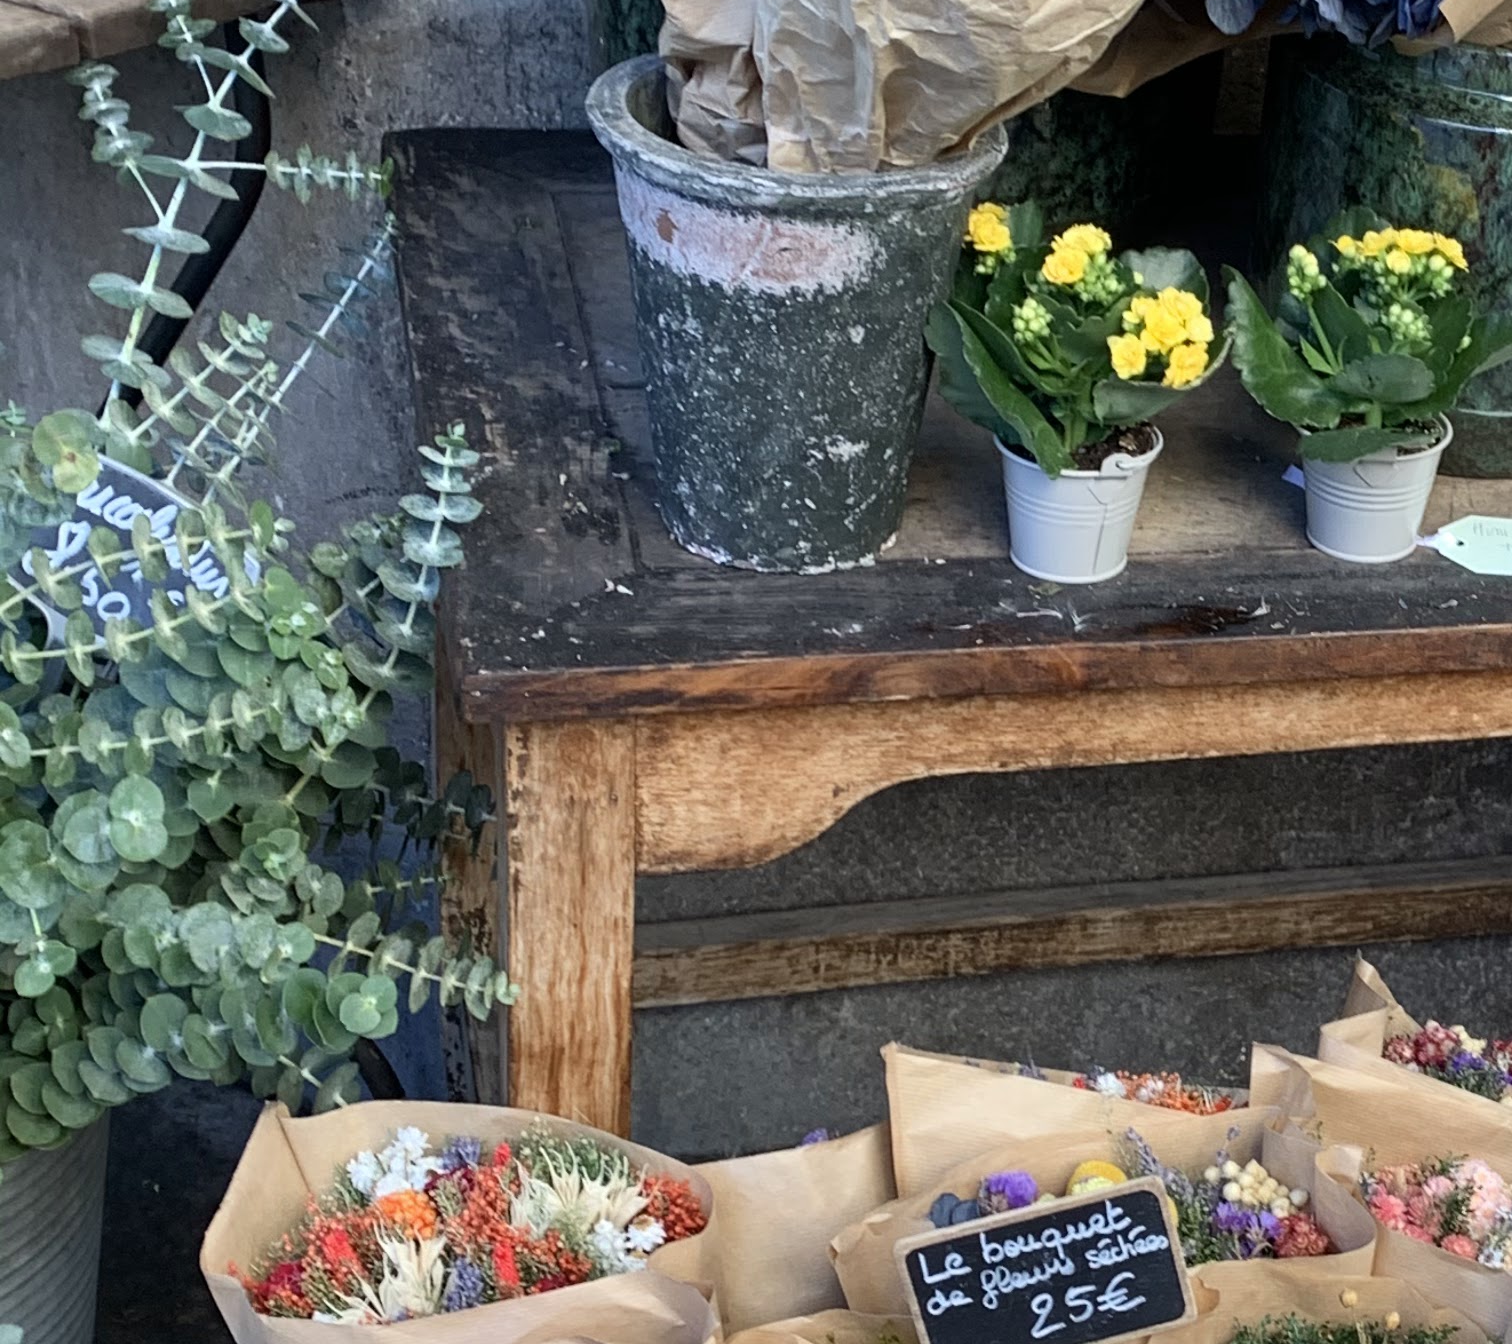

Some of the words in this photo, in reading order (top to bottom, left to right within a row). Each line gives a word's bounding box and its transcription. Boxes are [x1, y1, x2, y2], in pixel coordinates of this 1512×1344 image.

[918, 1253, 972, 1285] Le
[980, 1199, 1132, 1264] bouquet
[926, 1289, 974, 1316] de
[981, 1256, 1075, 1310] fleurs
[1030, 1271, 1146, 1339] 25€
